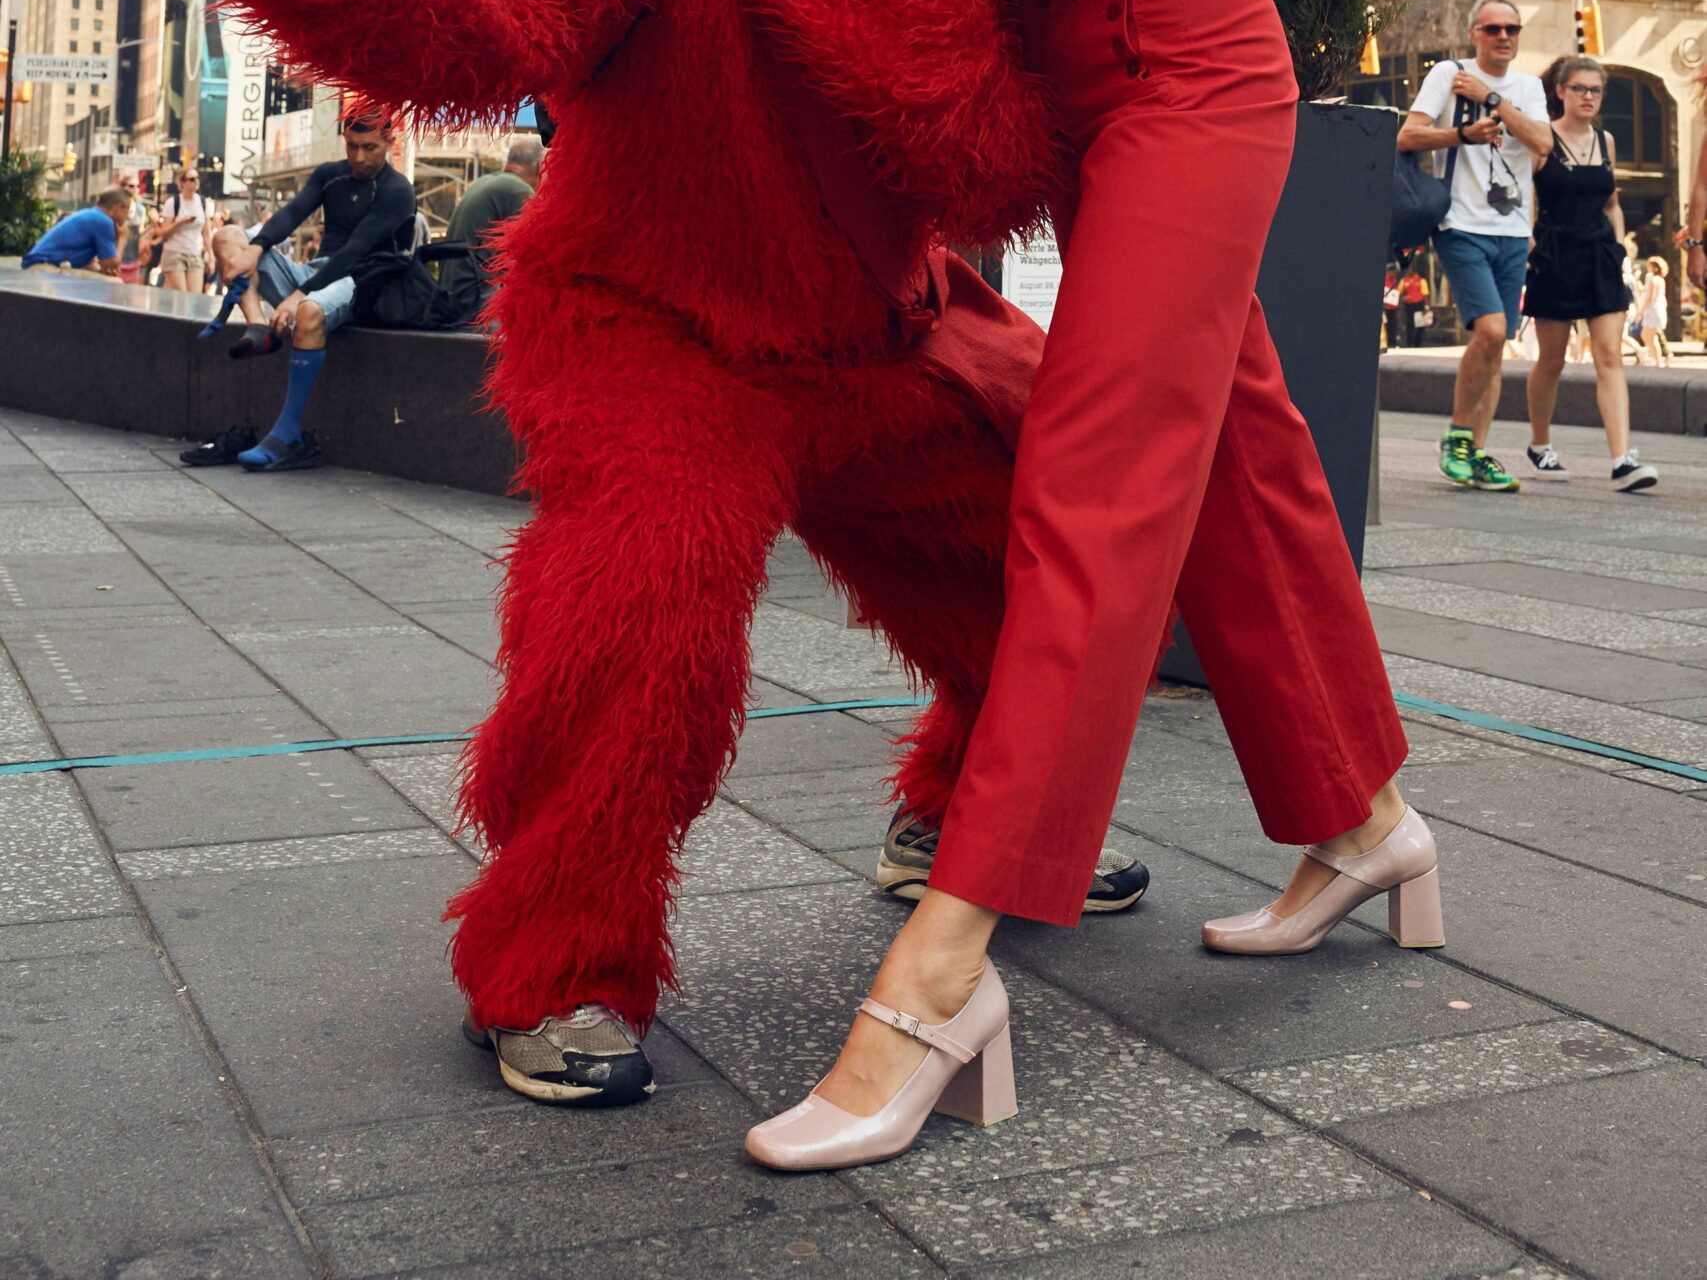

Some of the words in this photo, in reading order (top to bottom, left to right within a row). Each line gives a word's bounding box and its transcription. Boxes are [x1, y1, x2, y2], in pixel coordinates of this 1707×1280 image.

[27, 58, 69, 67] PEDESTRIAN
[71, 59, 89, 68] FLOW
[91, 60, 109, 69] ZONE
[26, 70, 43, 78] KEEP
[46, 70, 72, 79] MOVING
[240, 35, 263, 186] OVERGIRL
